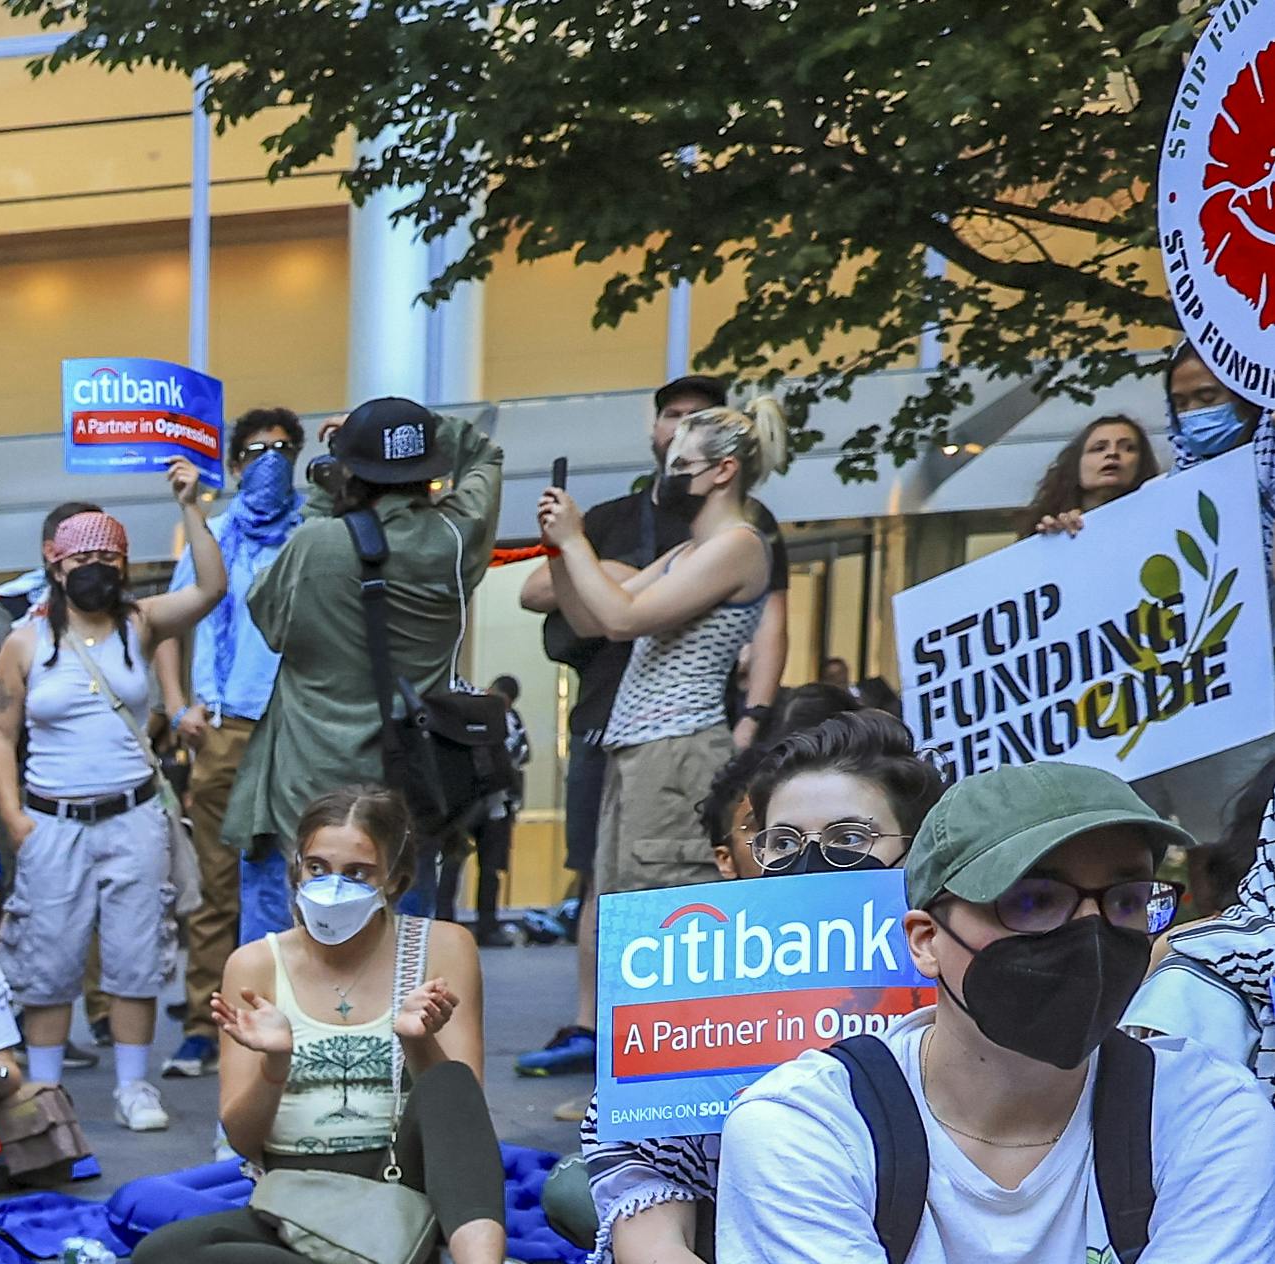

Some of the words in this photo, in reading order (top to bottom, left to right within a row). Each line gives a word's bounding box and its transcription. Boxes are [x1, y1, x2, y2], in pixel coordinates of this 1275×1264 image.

[1168, 56, 1206, 159] STOP
[1209, 0, 1257, 52] FU
[1165, 229, 1204, 320] STOP
[73, 371, 184, 408] citibank
[76, 419, 86, 434] A
[88, 419, 137, 435] Partner
[140, 417, 153, 433] in
[914, 583, 1060, 686] STOP
[919, 592, 1188, 740] FUNDING
[621, 900, 898, 989] citibank
[623, 1023, 645, 1055] A
[653, 1014, 768, 1051] Partner
[776, 1010, 804, 1041] in
[611, 1105, 672, 1124] BANKING
[675, 1103, 696, 1119] ON
